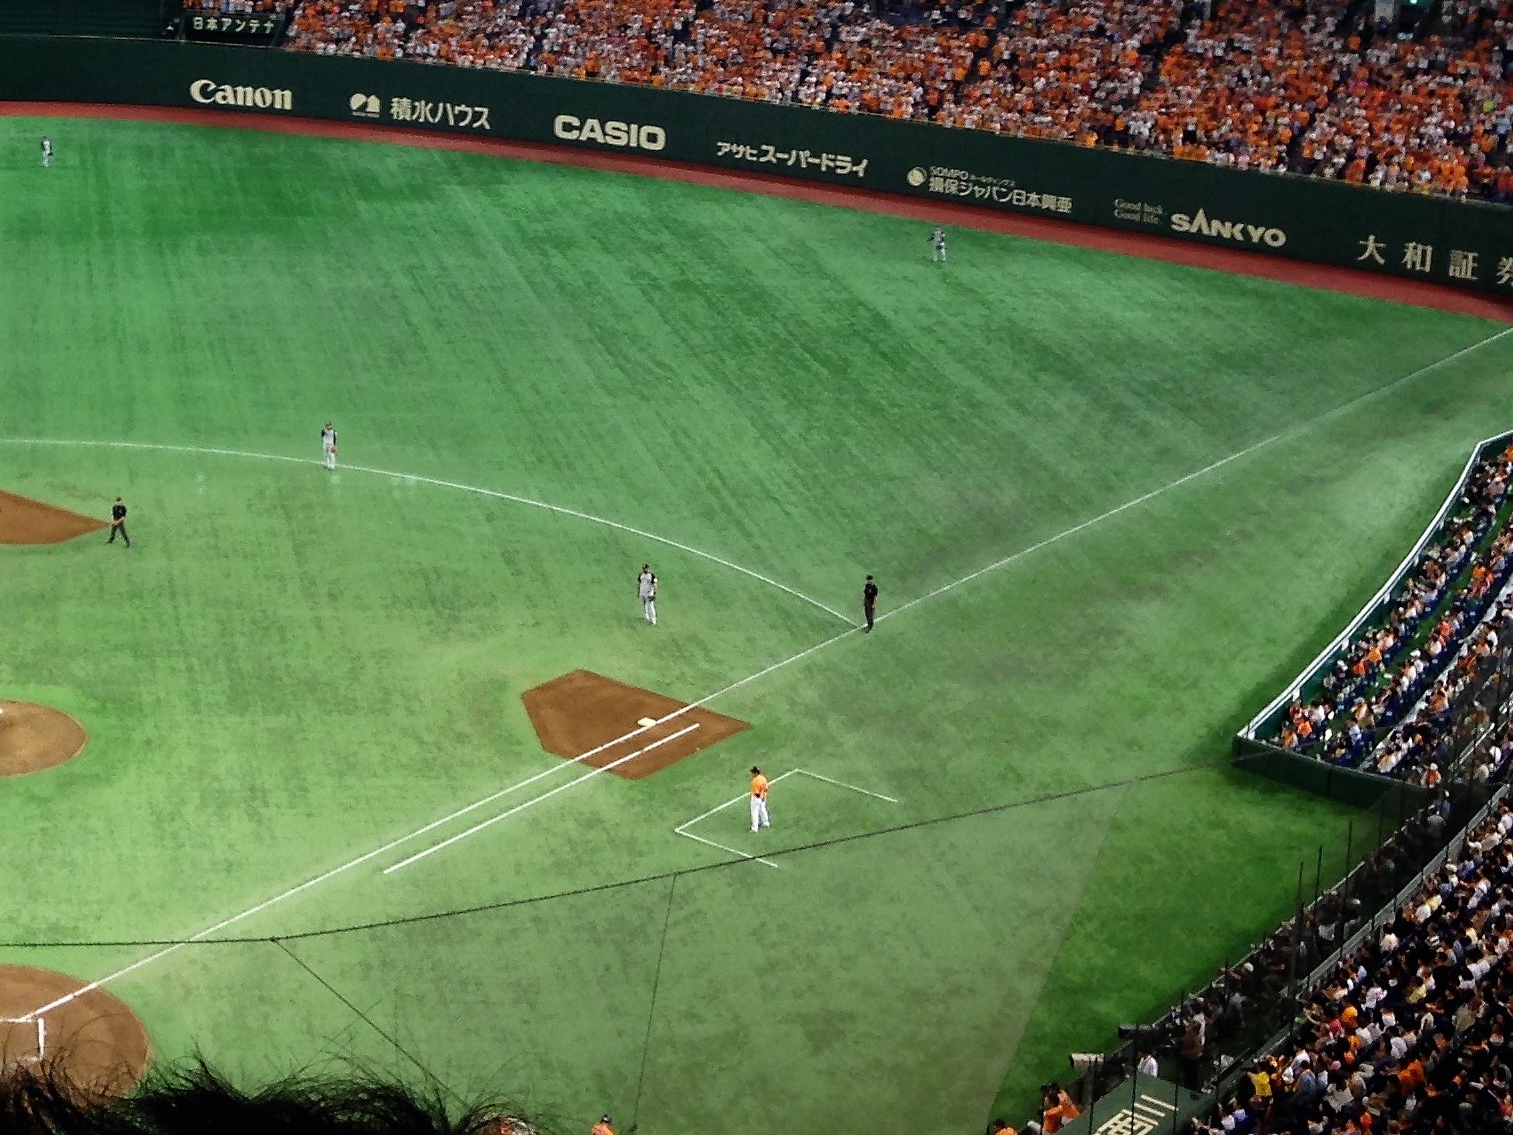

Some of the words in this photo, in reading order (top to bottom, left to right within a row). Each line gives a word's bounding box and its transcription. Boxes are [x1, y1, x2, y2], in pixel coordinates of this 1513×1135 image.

[192, 17, 275, 34] 日本アンテナ
[189, 79, 292, 111] Canon
[390, 97, 491, 131] 積水ハウス
[554, 115, 667, 151] CASIO
[1170, 207, 1287, 248] SANKYO
